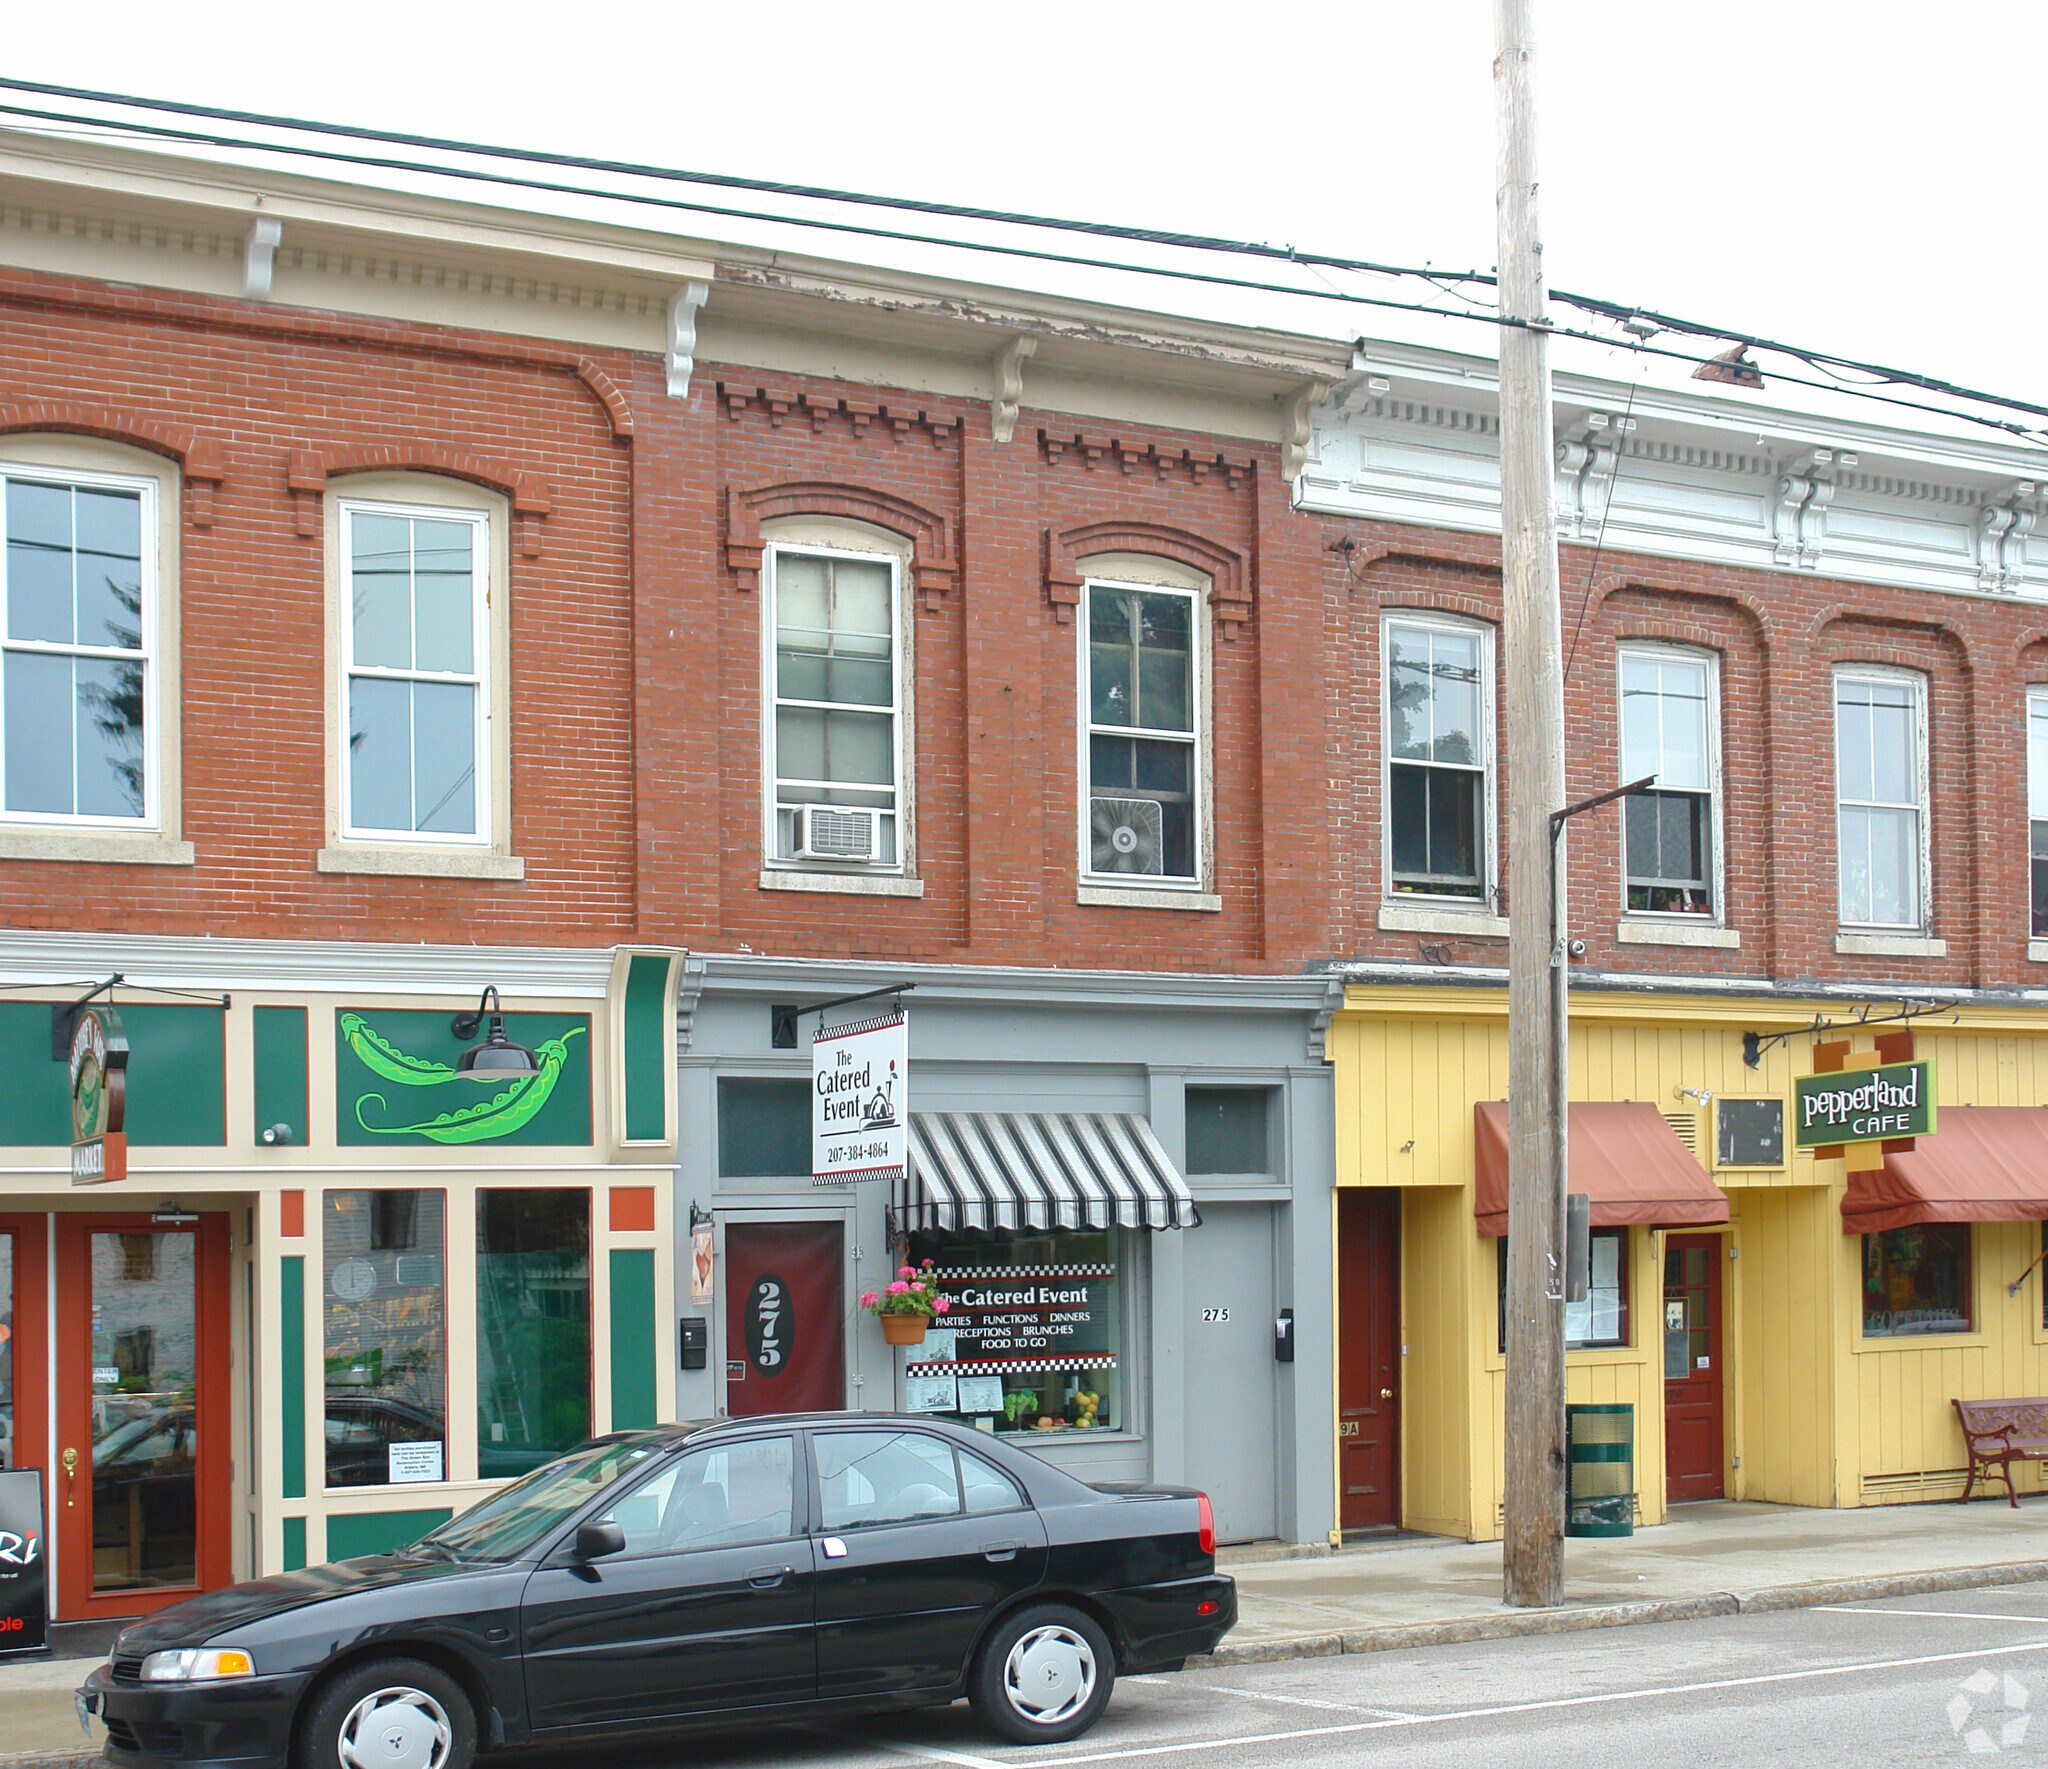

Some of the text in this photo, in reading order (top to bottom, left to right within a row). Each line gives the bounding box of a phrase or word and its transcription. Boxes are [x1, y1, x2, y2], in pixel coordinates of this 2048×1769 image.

[836, 1049, 852, 1067] The
[817, 1061, 871, 1096] Catered
[824, 1093, 860, 1122] Event
[1803, 1067, 1918, 1128] pepperland
[1852, 1113, 1910, 1135] CAFE
[73, 1143, 103, 1177] MARKET
[827, 1141, 889, 1163] 207-384-4864
[961, 1287, 1035, 1306] Catered
[1039, 1287, 1088, 1304] Event
[758, 1282, 781, 1366] 275
[935, 1311, 1091, 1327] PARTIES FUNCTIONS DINNERS
[1203, 1309, 1229, 1321] 275
[953, 1324, 1074, 1338] RECEPTIONS BRUNCHES
[981, 1337, 1047, 1350] FOOD TO GO
